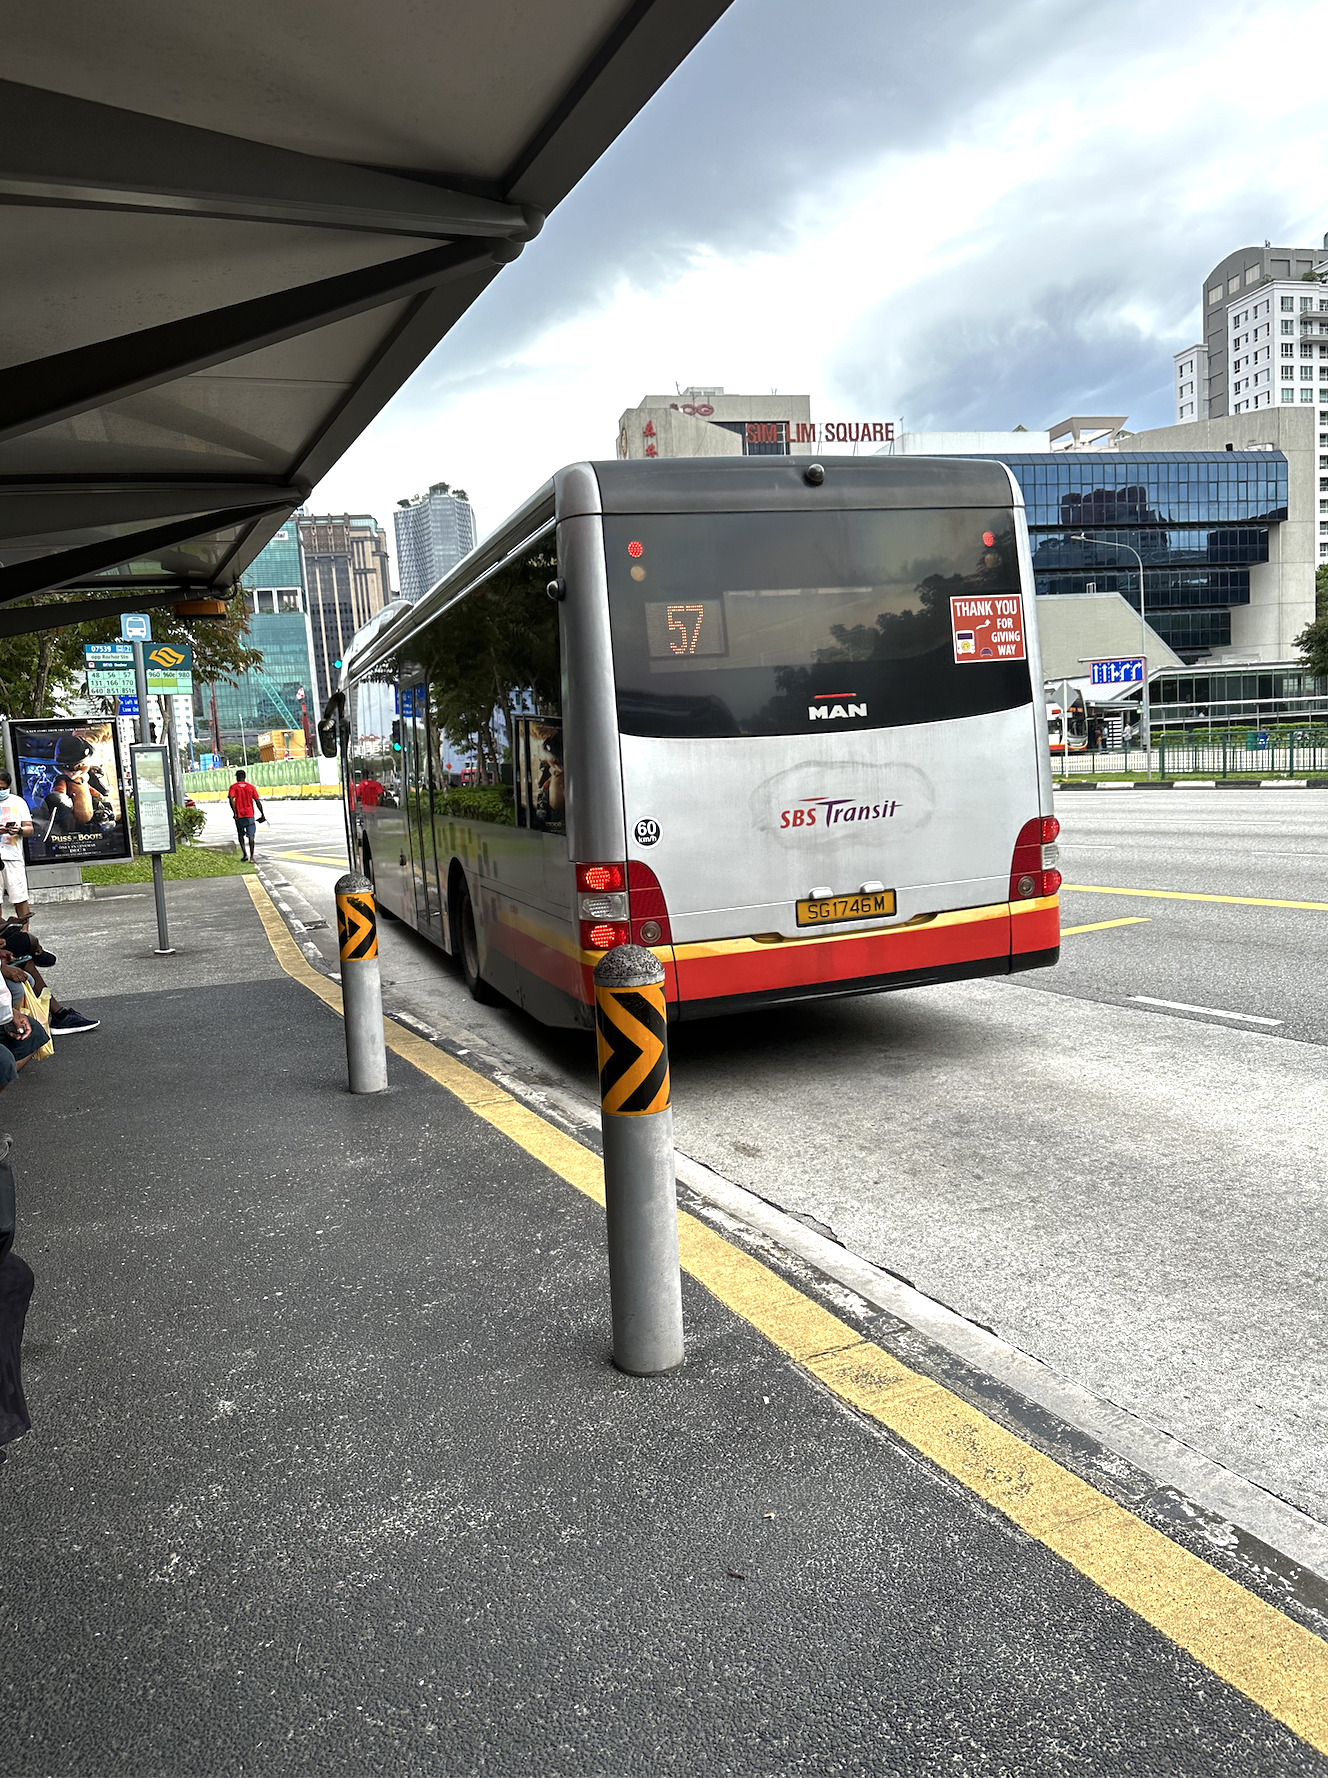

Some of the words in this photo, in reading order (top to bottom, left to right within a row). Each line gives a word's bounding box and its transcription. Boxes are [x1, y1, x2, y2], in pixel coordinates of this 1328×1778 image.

[746, 423, 777, 443] SIM
[786, 422, 816, 443] LIM
[825, 422, 895, 442] SQUARE
[954, 600, 993, 617] THANK
[995, 599, 1017, 615] YOU
[666, 604, 704, 655] 57
[996, 617, 1013, 629] FOR
[991, 630, 1020, 643] GIVING
[997, 644, 1016, 655] WAY
[808, 703, 868, 720] MAN
[780, 808, 817, 829] SBS
[815, 799, 904, 828] Transit
[637, 820, 657, 836] 60
[78, 832, 103, 841] BOOTS
[638, 835, 657, 843] km/h
[808, 895, 885, 920] SG1746M
